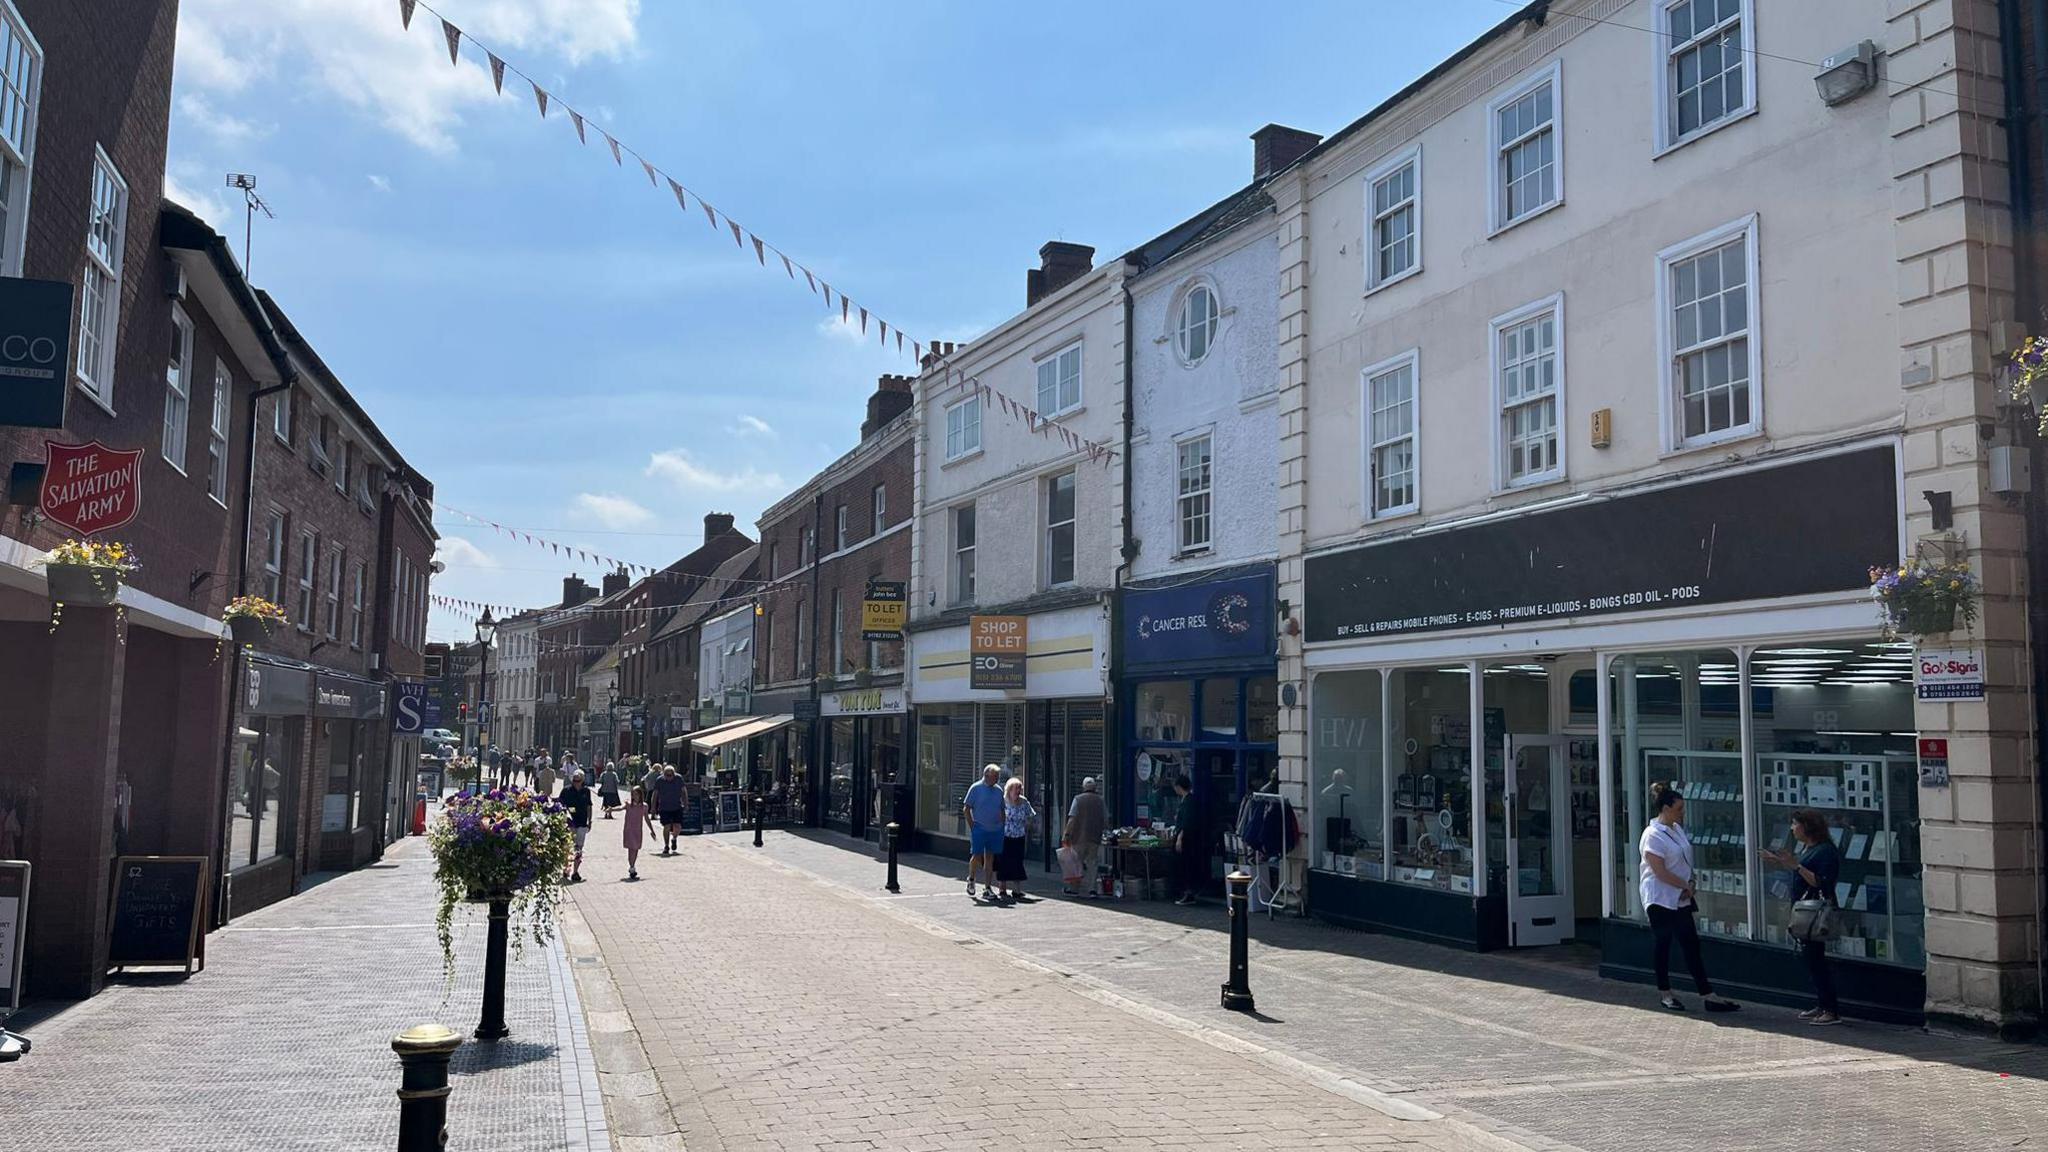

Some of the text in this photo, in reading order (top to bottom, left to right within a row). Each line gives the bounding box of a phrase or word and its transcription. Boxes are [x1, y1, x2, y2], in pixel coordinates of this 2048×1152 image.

[66, 454, 98, 478] THE
[47, 462, 132, 509] SALVATION
[75, 490, 126, 524] ARMY
[867, 603, 902, 613] TO LET
[1338, 626, 1350, 635] BUY
[1354, 623, 1369, 633] SELL
[1370, 623, 1375, 632] &
[1376, 619, 1403, 631] REPAIRS
[1403, 616, 1428, 629] MOBILE
[1429, 614, 1457, 626] PHONES
[1466, 610, 1492, 622] E-CIGS
[1499, 605, 1536, 618] PREMIUM
[1537, 600, 1581, 615] E-LIQUIDS
[1590, 595, 1621, 610] BONGS
[1623, 592, 1642, 605] CBD
[1645, 590, 1661, 602] OIL
[1671, 586, 1700, 600] PODS
[980, 621, 1018, 633] SHOP
[1152, 617, 1185, 632] CANCER
[975, 636, 1022, 648] TO LET
[401, 684, 424, 695] WH
[396, 695, 421, 731] S
